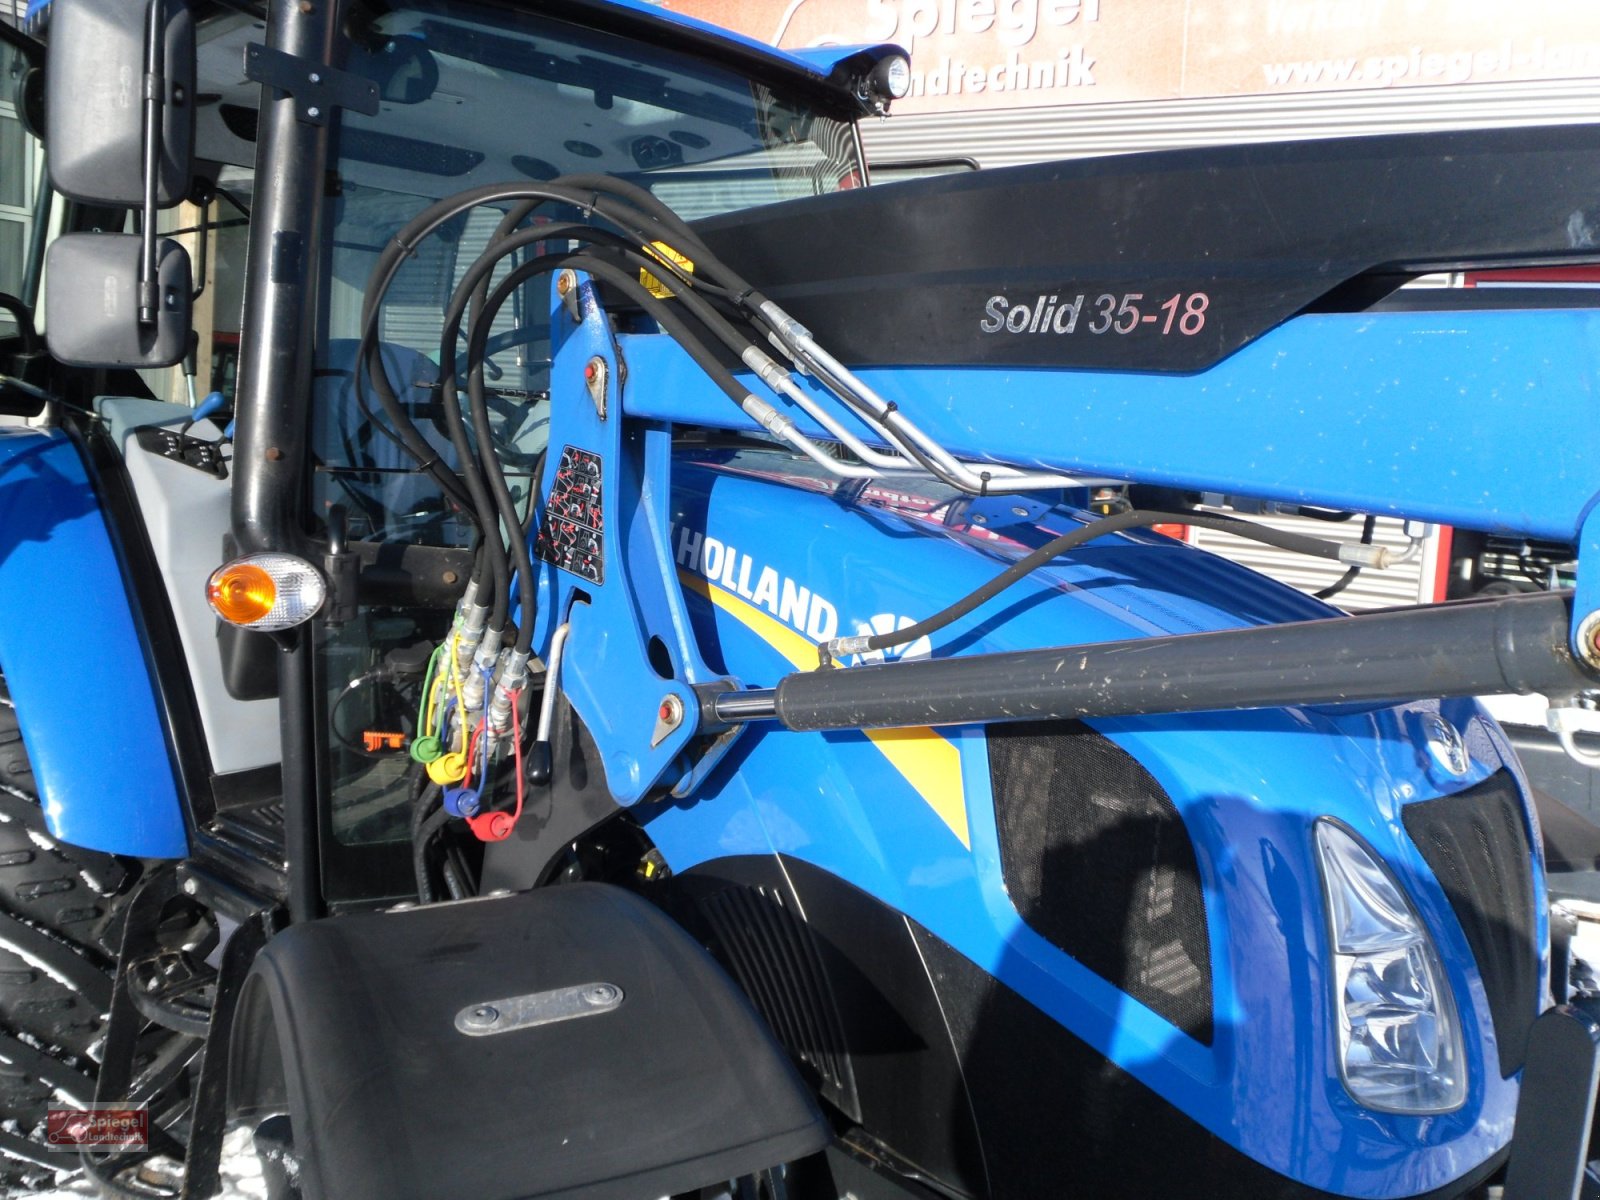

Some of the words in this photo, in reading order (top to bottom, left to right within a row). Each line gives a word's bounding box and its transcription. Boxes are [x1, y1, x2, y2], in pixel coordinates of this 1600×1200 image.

[909, 47, 1097, 97] ndtechnik
[980, 295, 1085, 334] Solid
[1089, 293, 1209, 336] 35-18
[677, 526, 838, 643] HOLLAND
